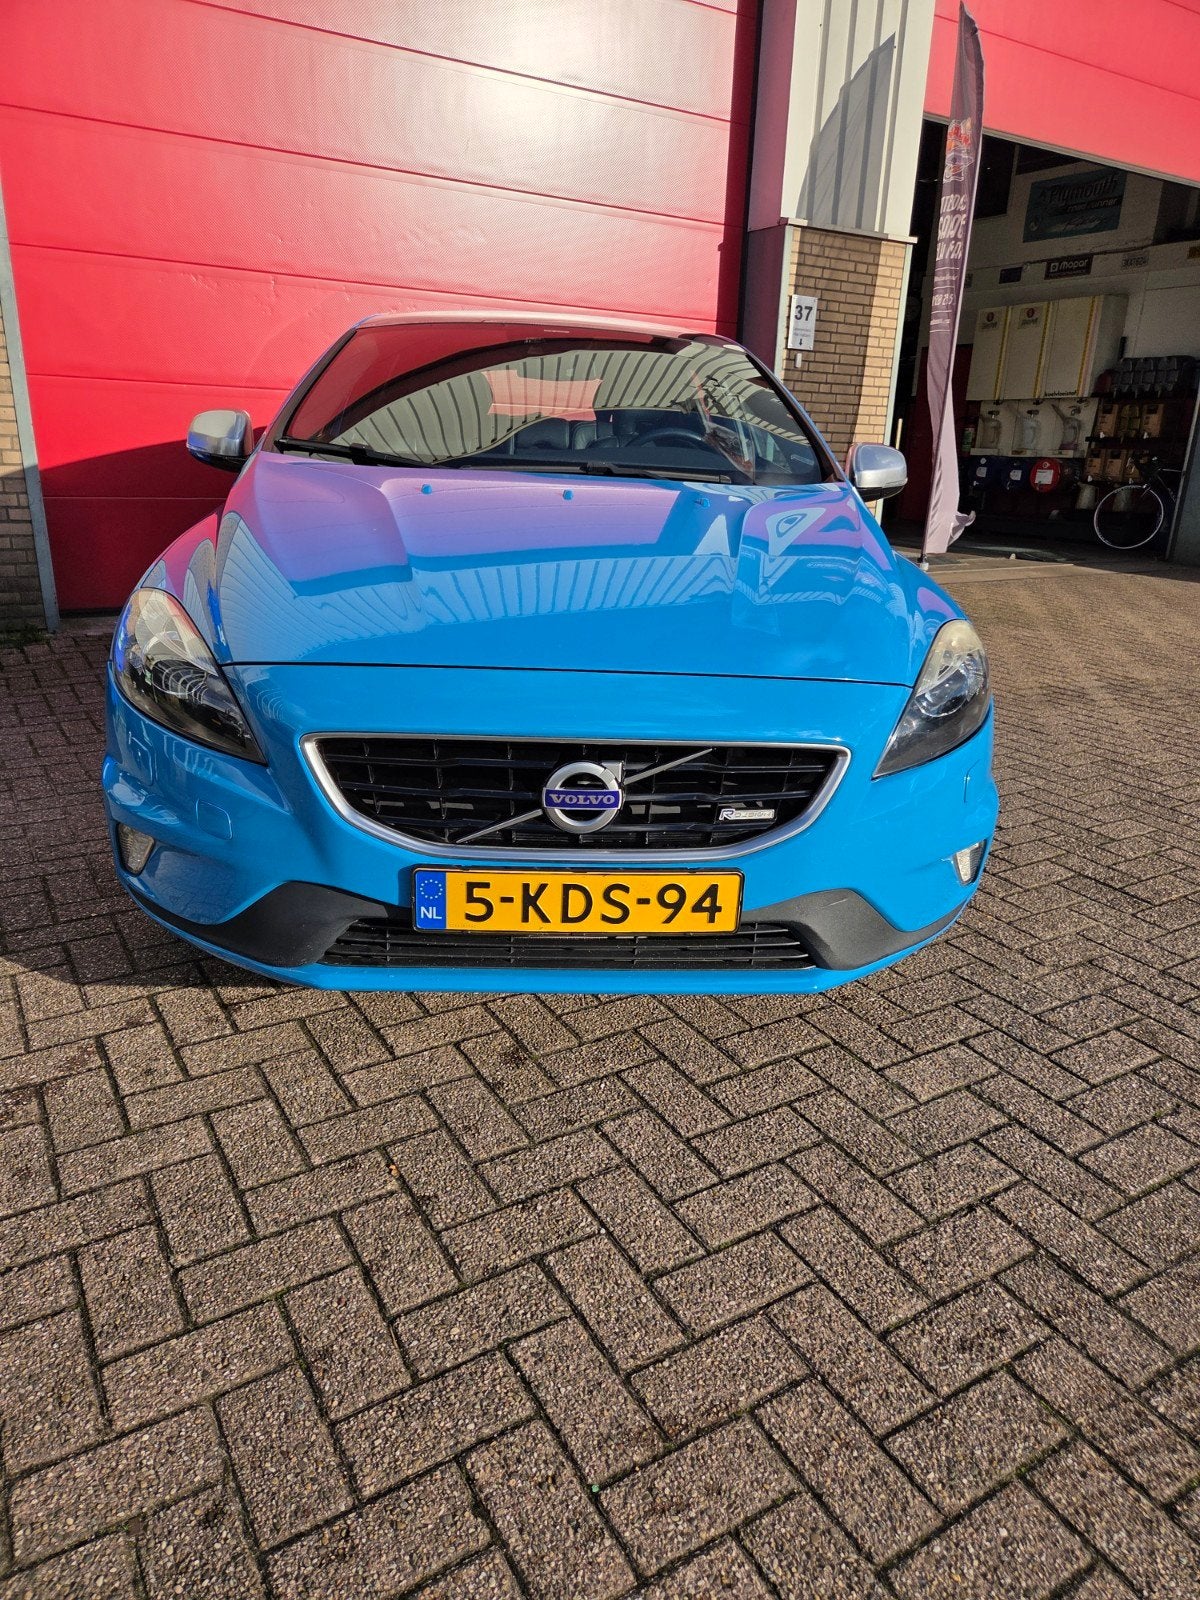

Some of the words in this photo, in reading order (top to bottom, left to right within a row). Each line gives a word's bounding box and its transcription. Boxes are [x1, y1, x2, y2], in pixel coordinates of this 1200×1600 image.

[794, 304, 813, 322] 37
[549, 793, 616, 805] VOLVO
[463, 881, 723, 925] 5-KDS-94
[420, 906, 443, 920] NL
